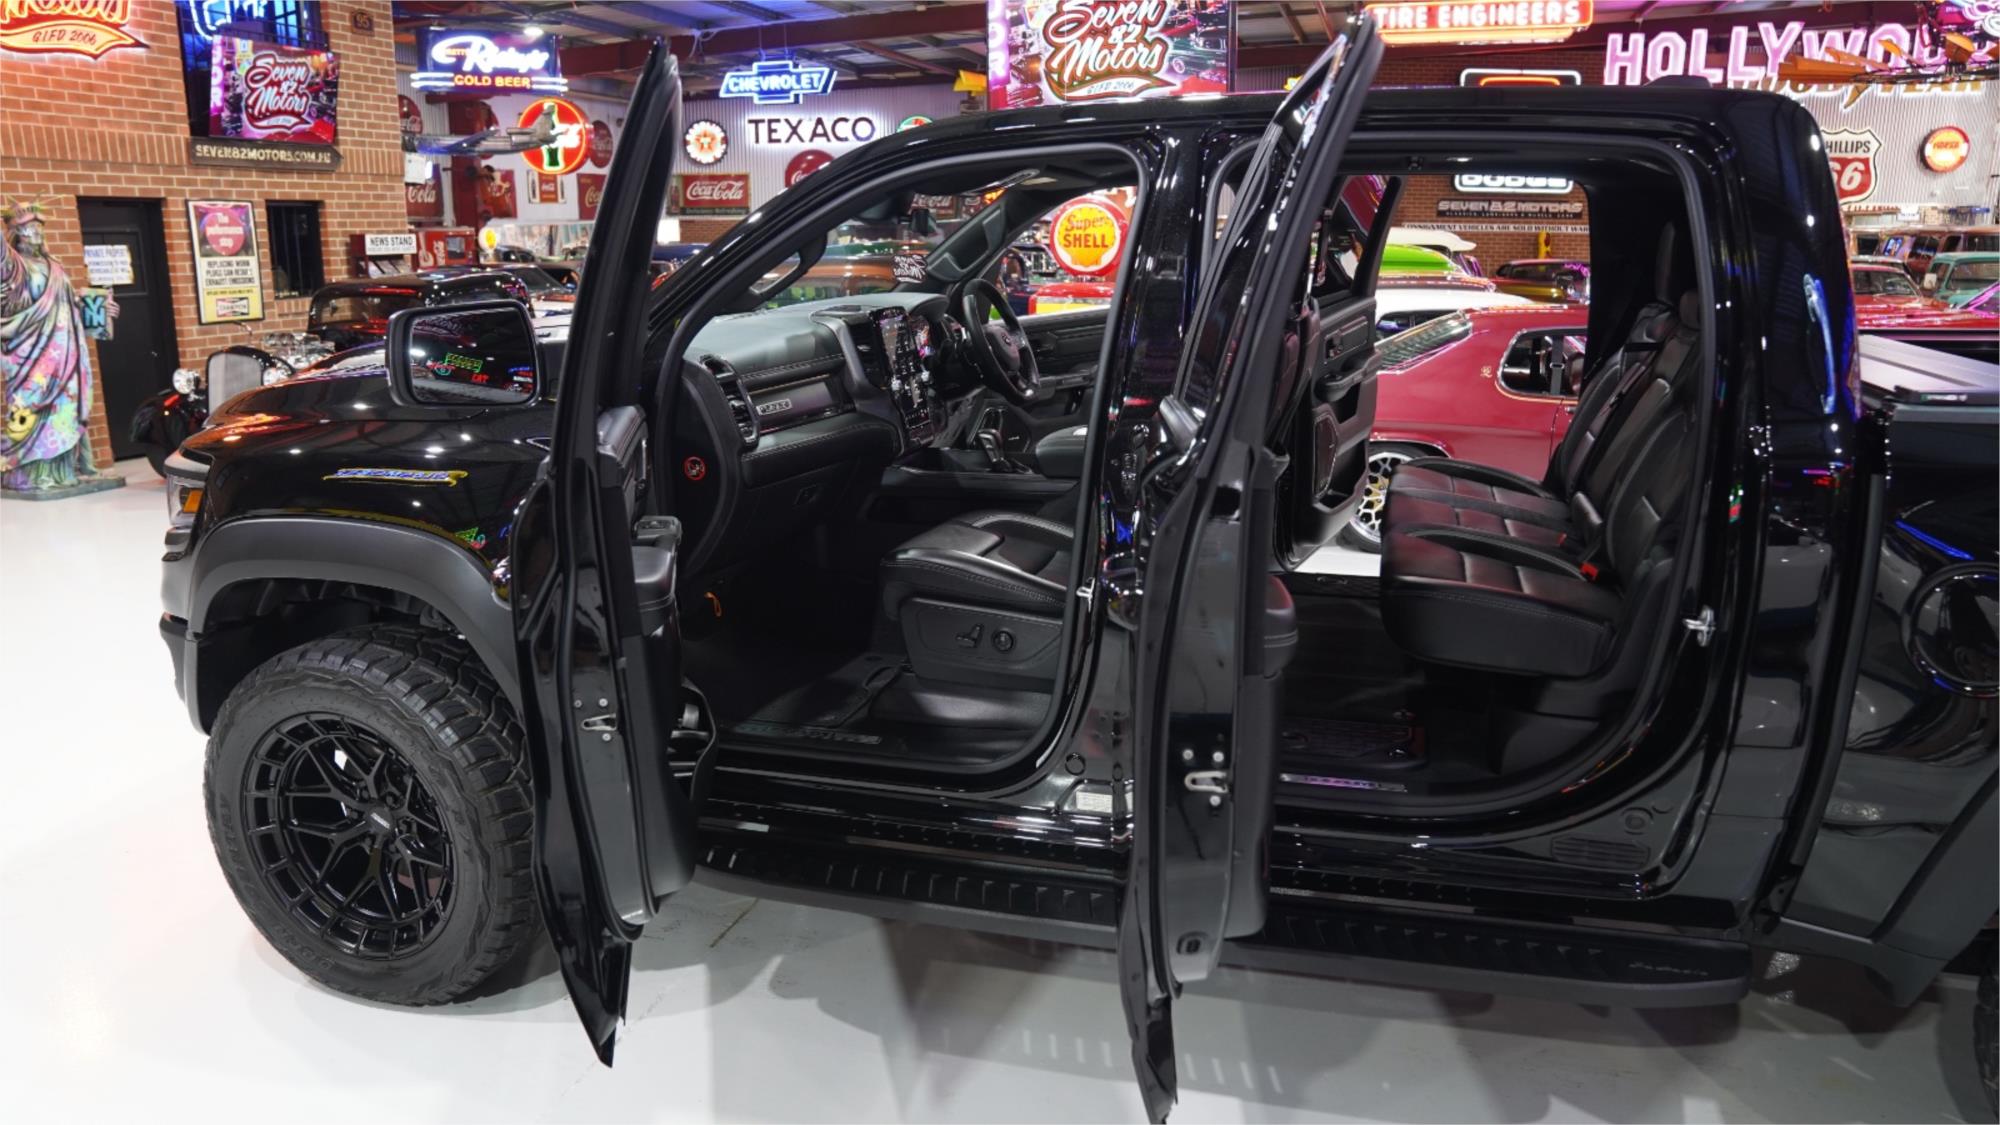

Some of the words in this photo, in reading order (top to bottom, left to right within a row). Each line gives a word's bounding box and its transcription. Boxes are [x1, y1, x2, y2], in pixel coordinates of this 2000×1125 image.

[1050, 0, 1159, 42] Seven
[1373, 4, 1428, 28] TIRE
[1438, 1, 1581, 26] ENGINEERS
[1108, 24, 1138, 45] 82
[1052, 38, 1164, 83] Motors
[1603, 21, 1998, 88] HOLLYWO
[248, 53, 307, 87] Seven
[454, 75, 492, 86] COLD
[495, 77, 532, 89] BEER
[728, 73, 823, 92] CHEVROLET
[249, 86, 306, 116] Motors
[748, 117, 876, 144] TEXACO
[1826, 140, 1871, 153] HILLIPS
[1438, 201, 1488, 211] SEVEN
[1517, 202, 1584, 213] MOTORS
[370, 236, 389, 246] NEWS
[391, 236, 413, 246] STAND
[1063, 232, 1109, 248] SHELL
